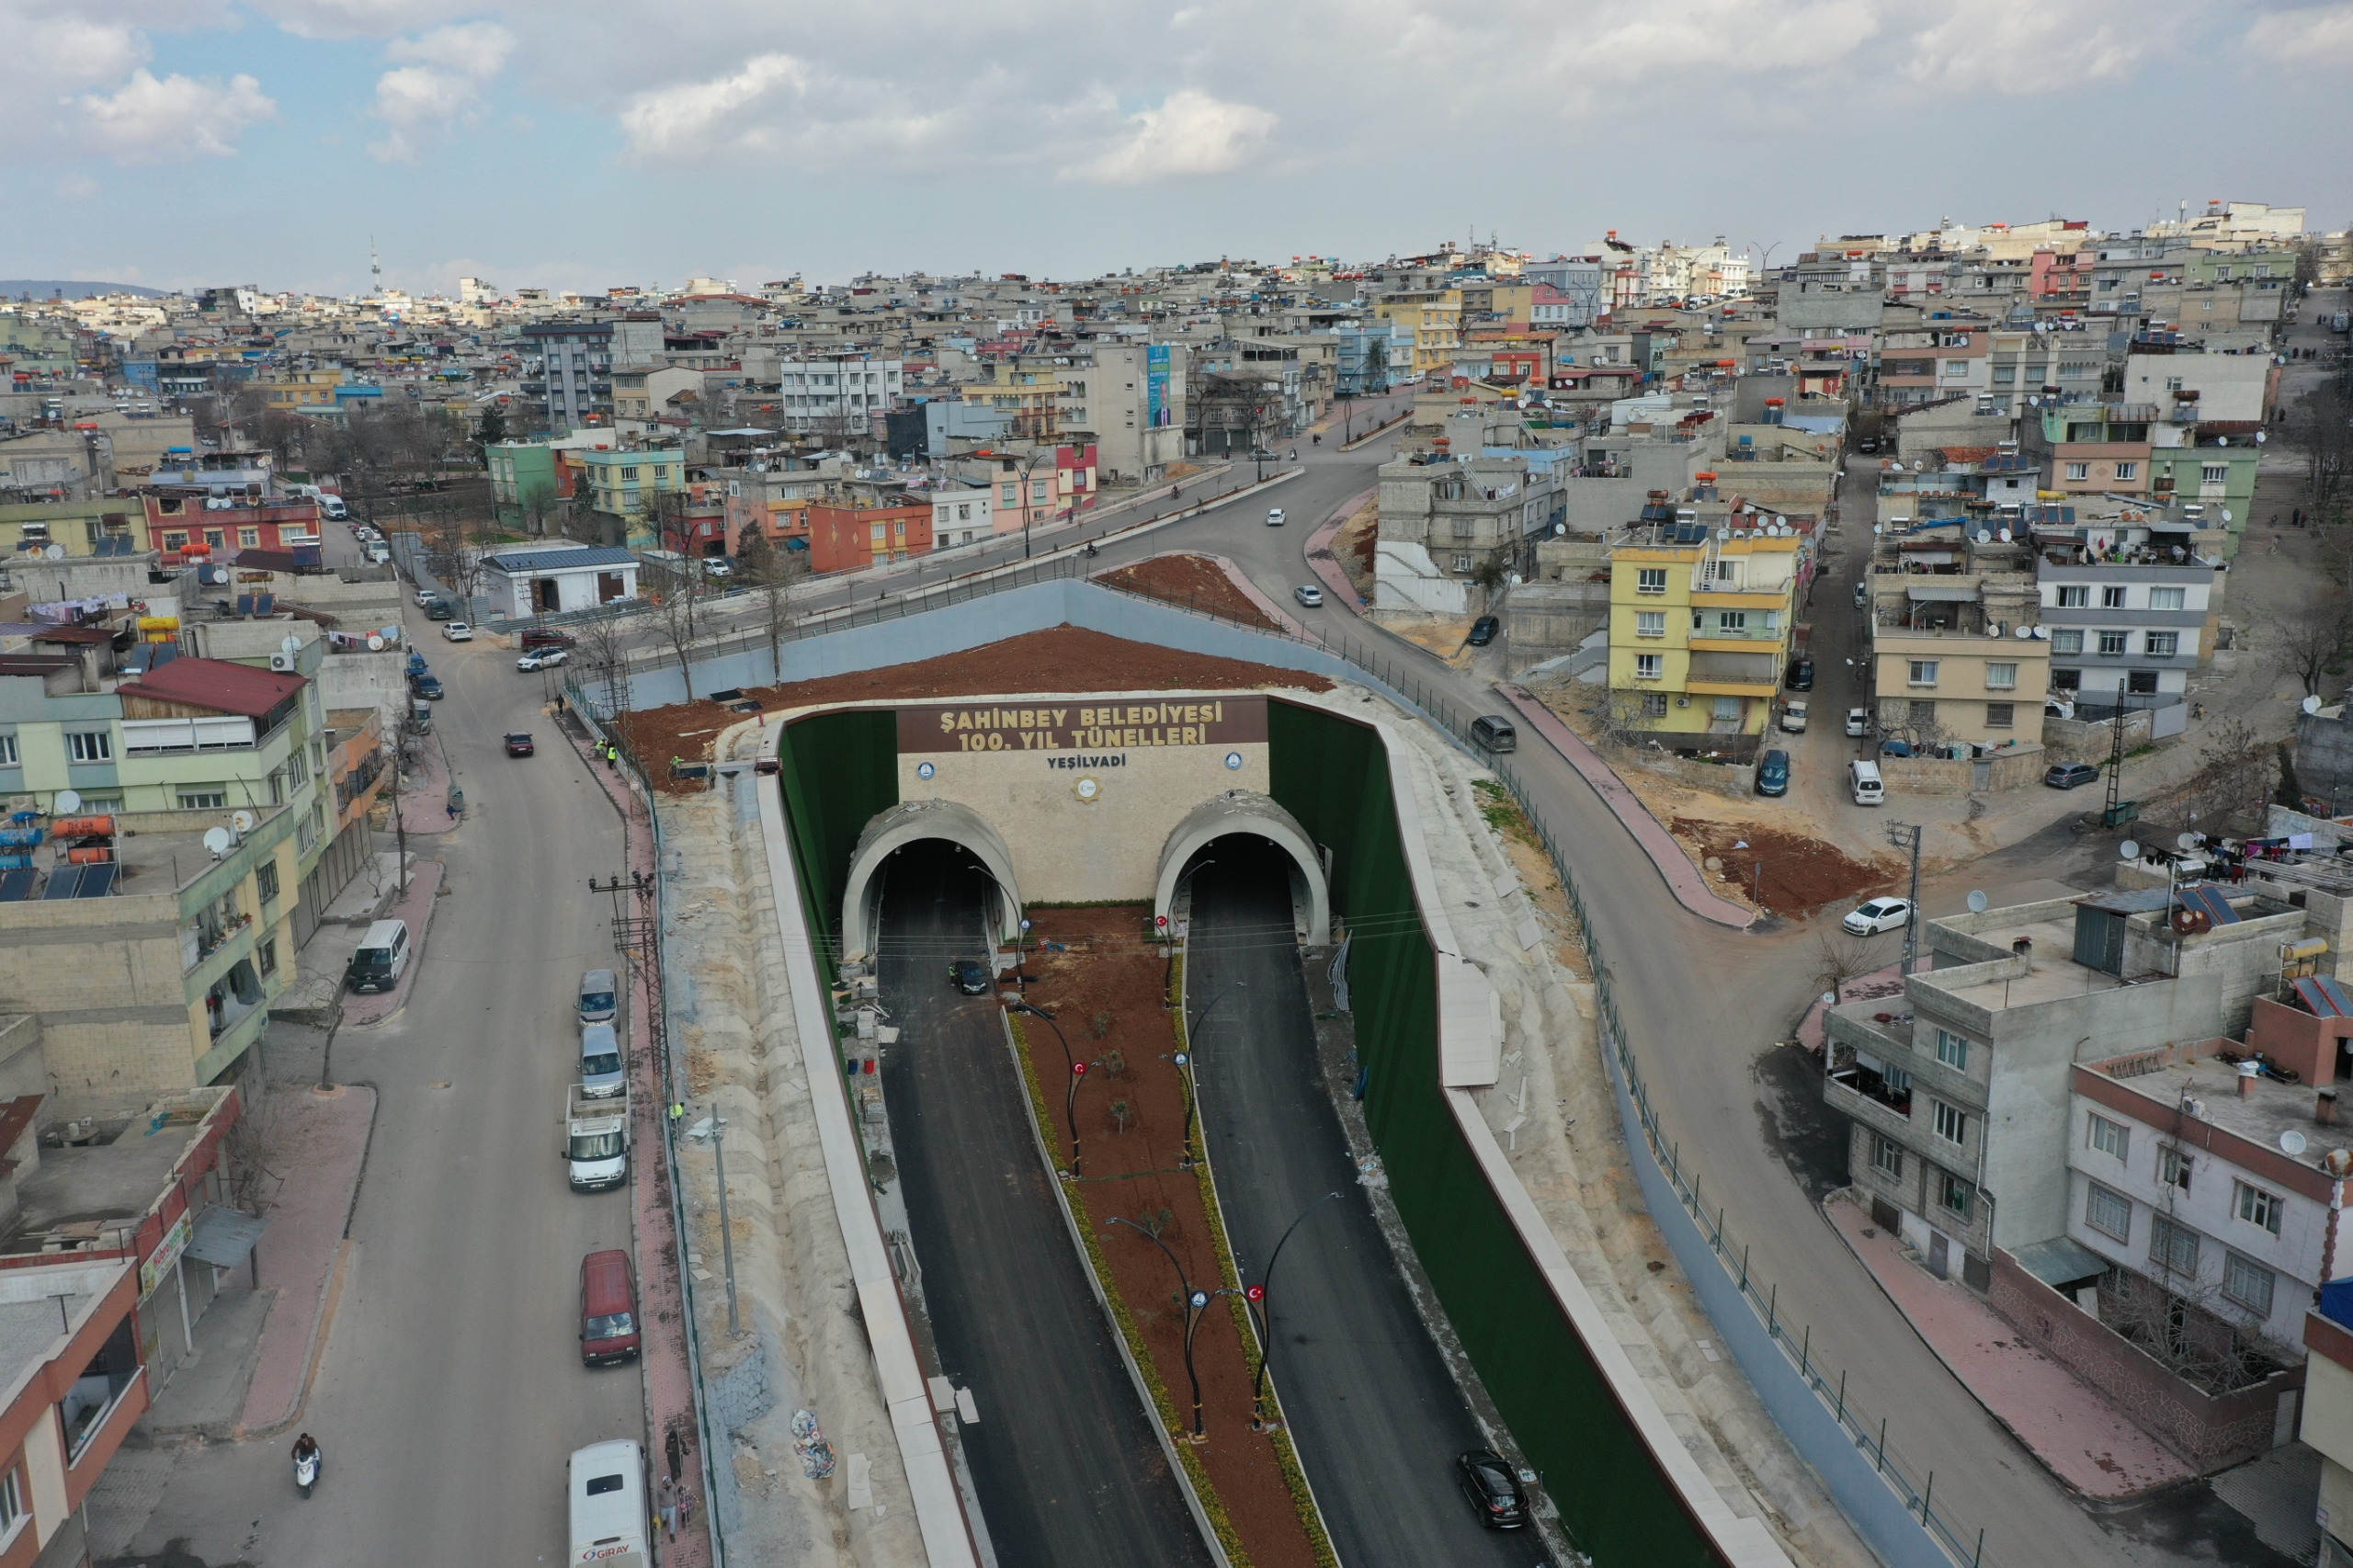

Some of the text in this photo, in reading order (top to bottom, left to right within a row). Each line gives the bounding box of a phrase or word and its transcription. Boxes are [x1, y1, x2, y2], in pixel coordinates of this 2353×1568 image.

[940, 700, 1222, 733] ŞAHİNBEY BELEDİYESİ
[959, 722, 1206, 752] 100. YIL TÜNELLERİ
[1047, 753, 1126, 770] YEŞİLVADİ
